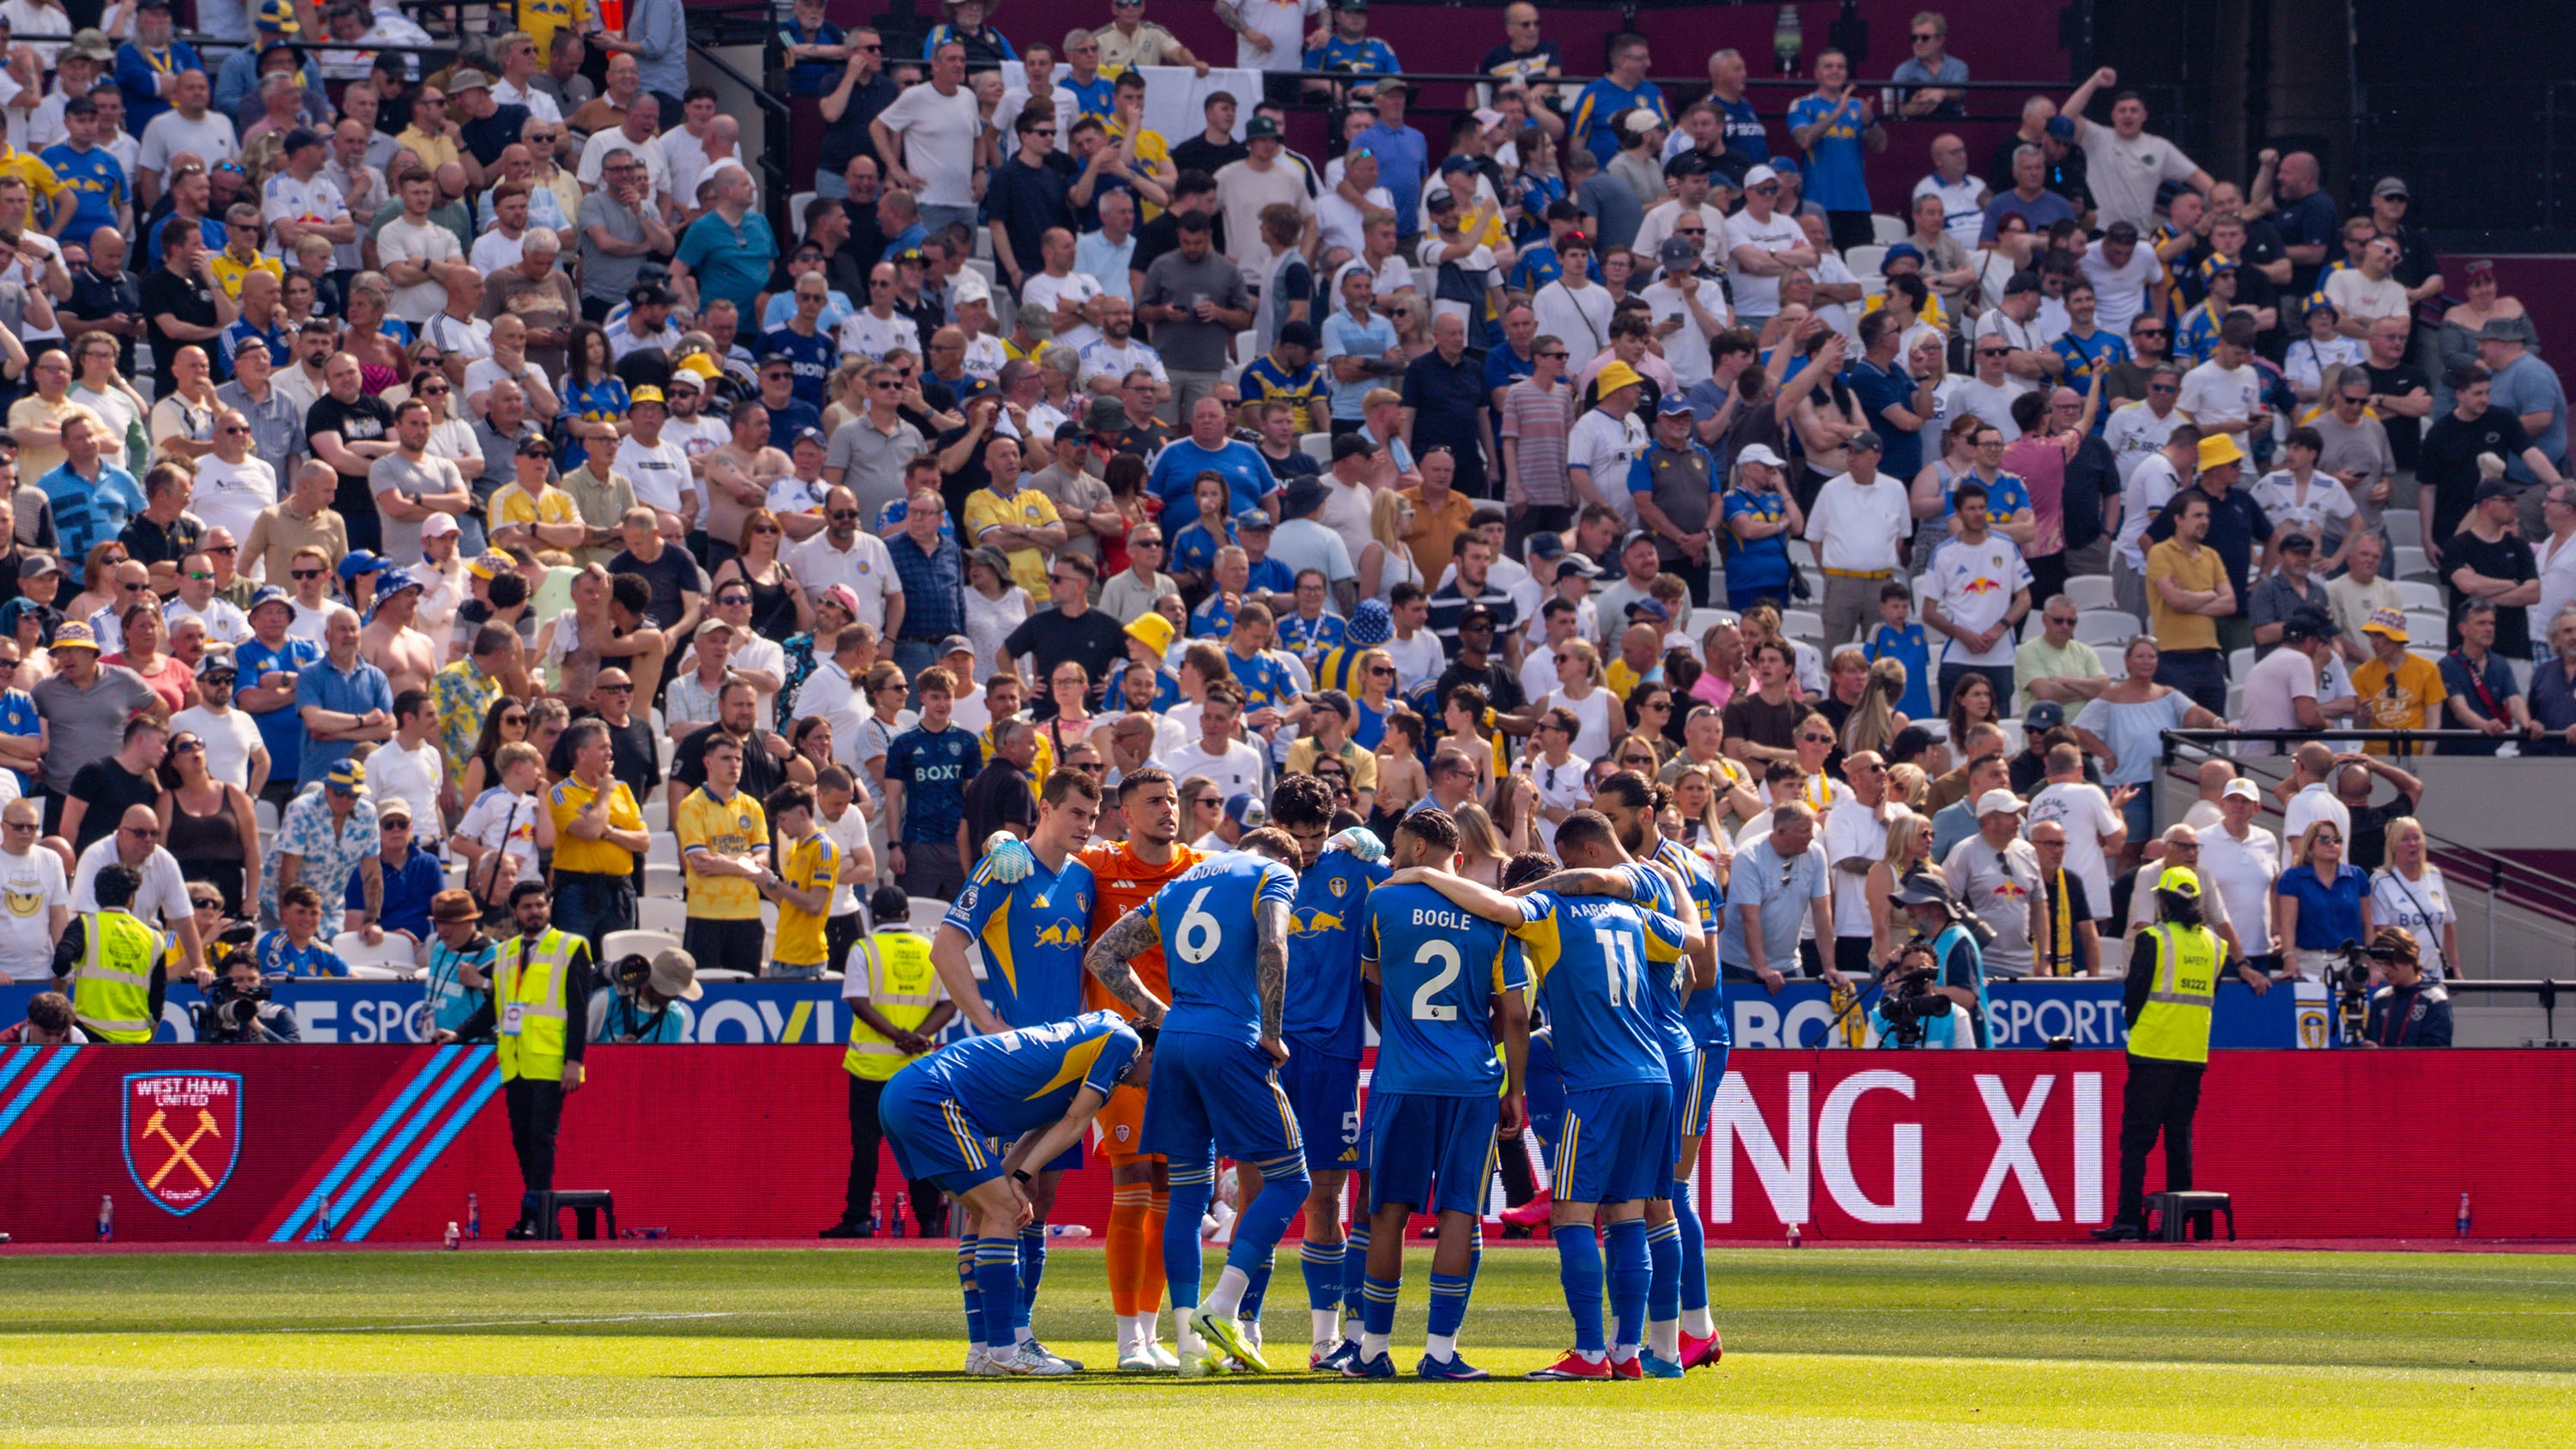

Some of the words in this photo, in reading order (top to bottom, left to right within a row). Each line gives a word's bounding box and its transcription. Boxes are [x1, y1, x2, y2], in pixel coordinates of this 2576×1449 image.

[1175, 886, 1222, 965] 6
[1413, 909, 1472, 931] BOGLE
[1412, 939, 1461, 1021] 2
[1595, 928, 1638, 1009] 11
[137, 1077, 185, 1095] WEST
[186, 1077, 229, 1096] HAM
[155, 1093, 210, 1106] UNITED
[1341, 1111, 1360, 1144] 5
[1965, 1071, 2104, 1224] XI
